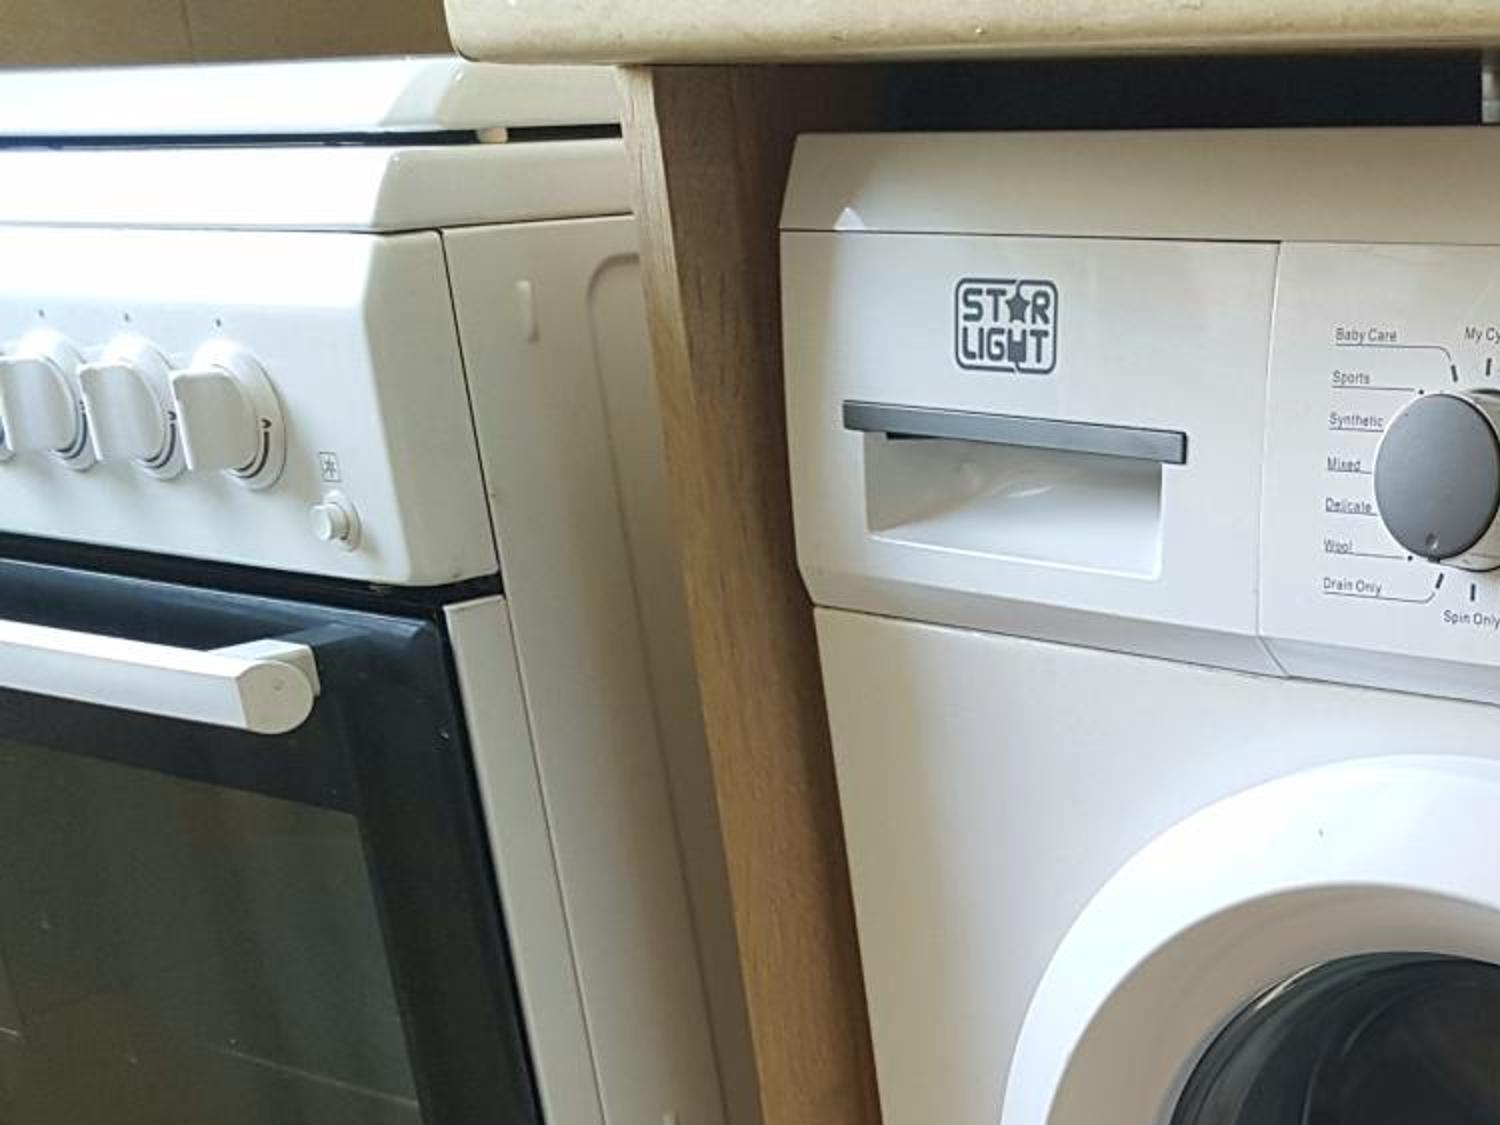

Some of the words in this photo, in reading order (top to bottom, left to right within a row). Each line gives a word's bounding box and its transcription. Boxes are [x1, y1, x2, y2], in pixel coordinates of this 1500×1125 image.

[1335, 327, 1366, 345] Baby
[1367, 328, 1398, 342] Care
[1464, 326, 1483, 342] My
[962, 326, 1050, 364] LIGHT
[1332, 369, 1371, 386] Sports
[1329, 411, 1385, 428] Synthetic
[1327, 456, 1362, 473] Mixed
[1325, 497, 1373, 514] Delicate
[1324, 538, 1354, 554] Wool
[1323, 577, 1354, 592] Drain
[1355, 579, 1382, 597] Only
[1443, 609, 1471, 625] Spin
